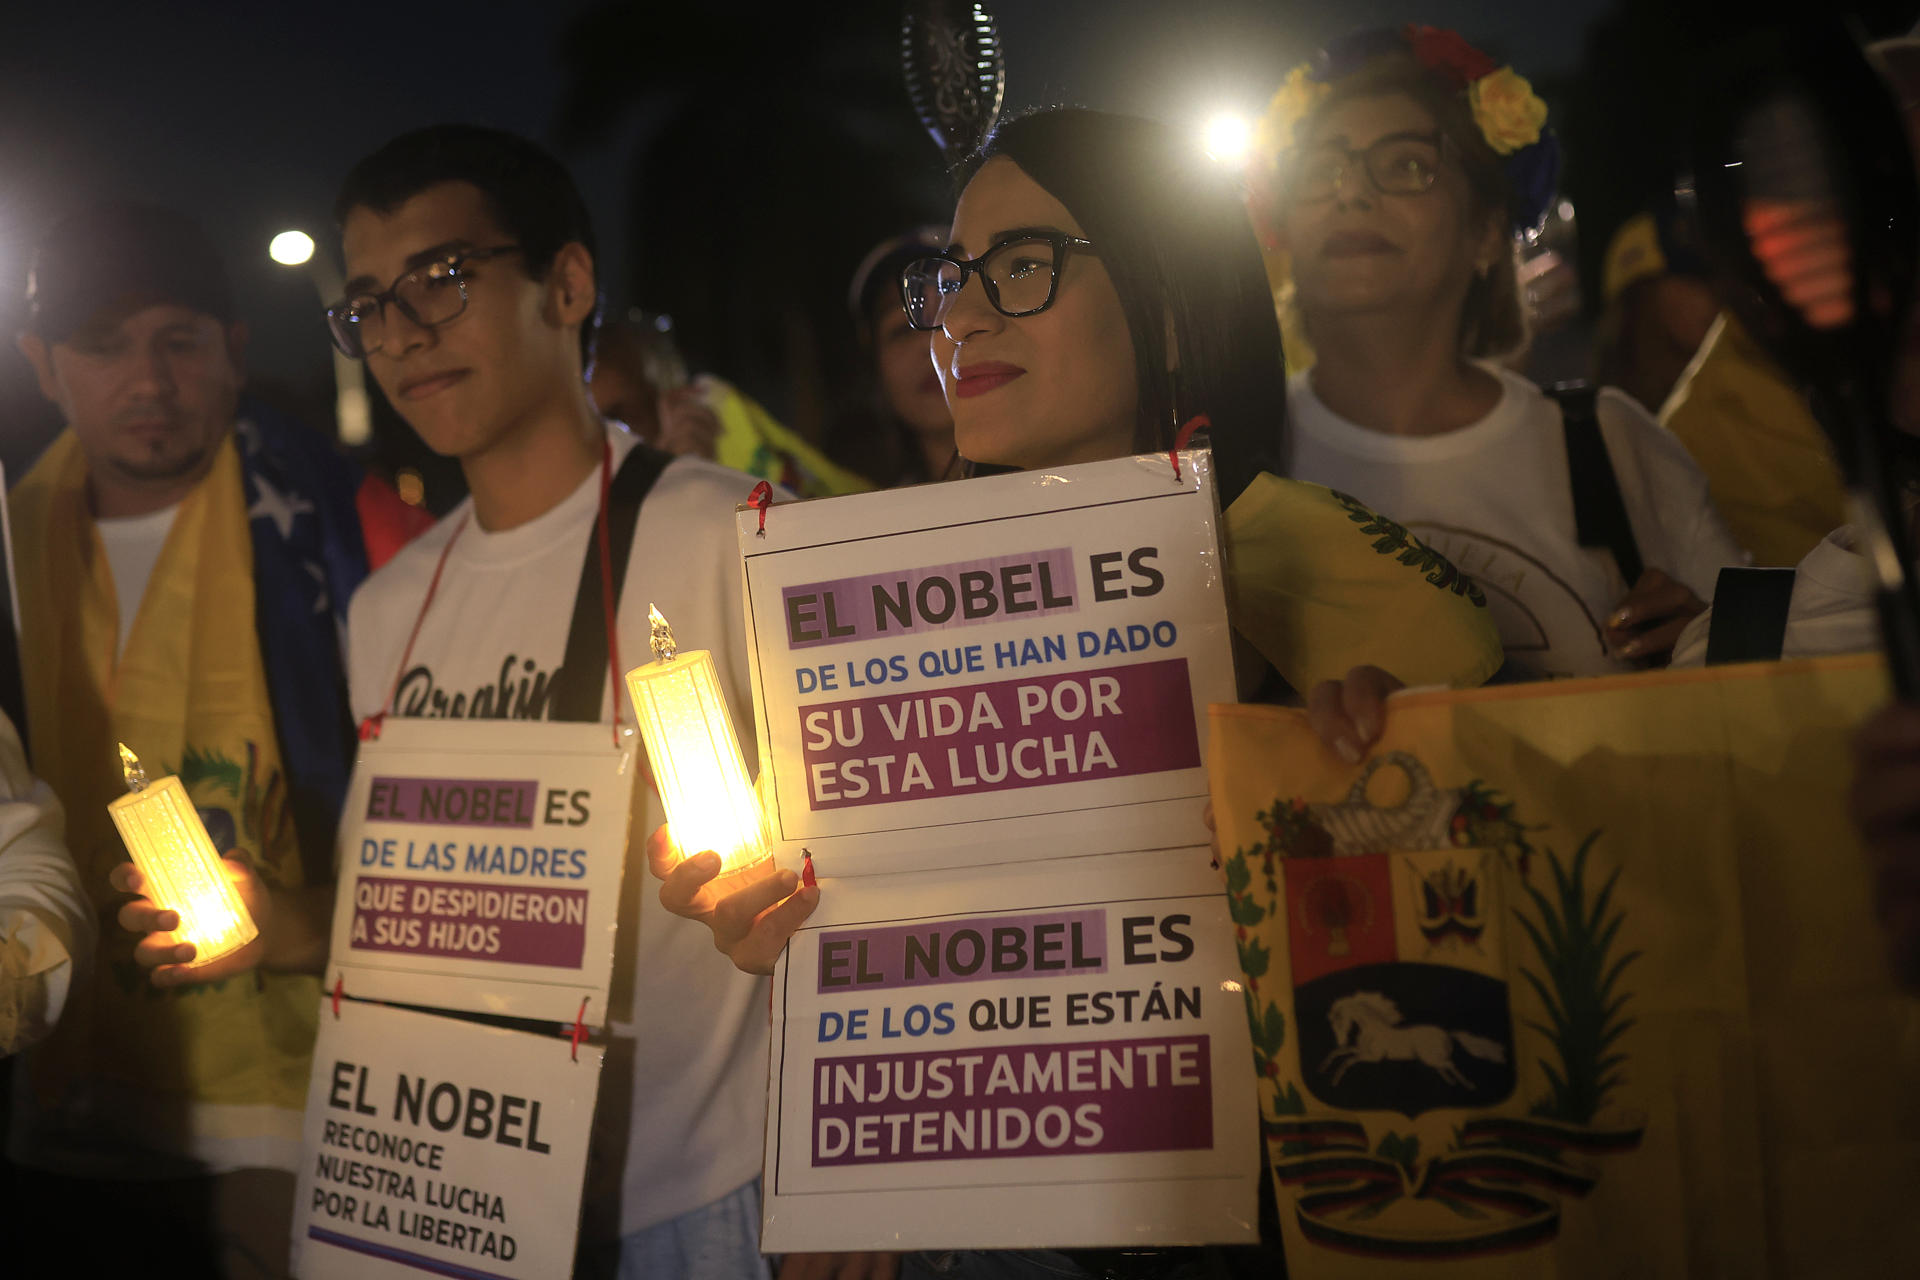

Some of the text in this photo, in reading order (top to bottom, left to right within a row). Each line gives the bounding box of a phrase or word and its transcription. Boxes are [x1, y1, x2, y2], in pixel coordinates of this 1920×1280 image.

[786, 546, 1165, 643] EL NOBEL ES
[796, 620, 1178, 693] DE LOS QUE HAN DADO
[805, 676, 1124, 752] SU VIDA POR
[811, 730, 1119, 802] ESTA LUCHA
[367, 782, 591, 827] EL NOBEL ES
[360, 838, 587, 880] DE LAS MADRES
[352, 917, 501, 954] A SUS HIJOS
[356, 882, 584, 925] QUE DESPIDIERON
[821, 914, 1195, 987] EL NOBEL ES
[817, 982, 1201, 1043] DE LOS QUE ESTÁN
[818, 1044, 1200, 1105] INJUSTAMENTE
[328, 1061, 551, 1155] EL NOBEL
[817, 1104, 1104, 1159] DETENIDOS
[322, 1119, 446, 1171] RECONOCE
[315, 1153, 506, 1224] NUESTRA LUCHA
[311, 1187, 518, 1262] POR LA LIBERTAD
